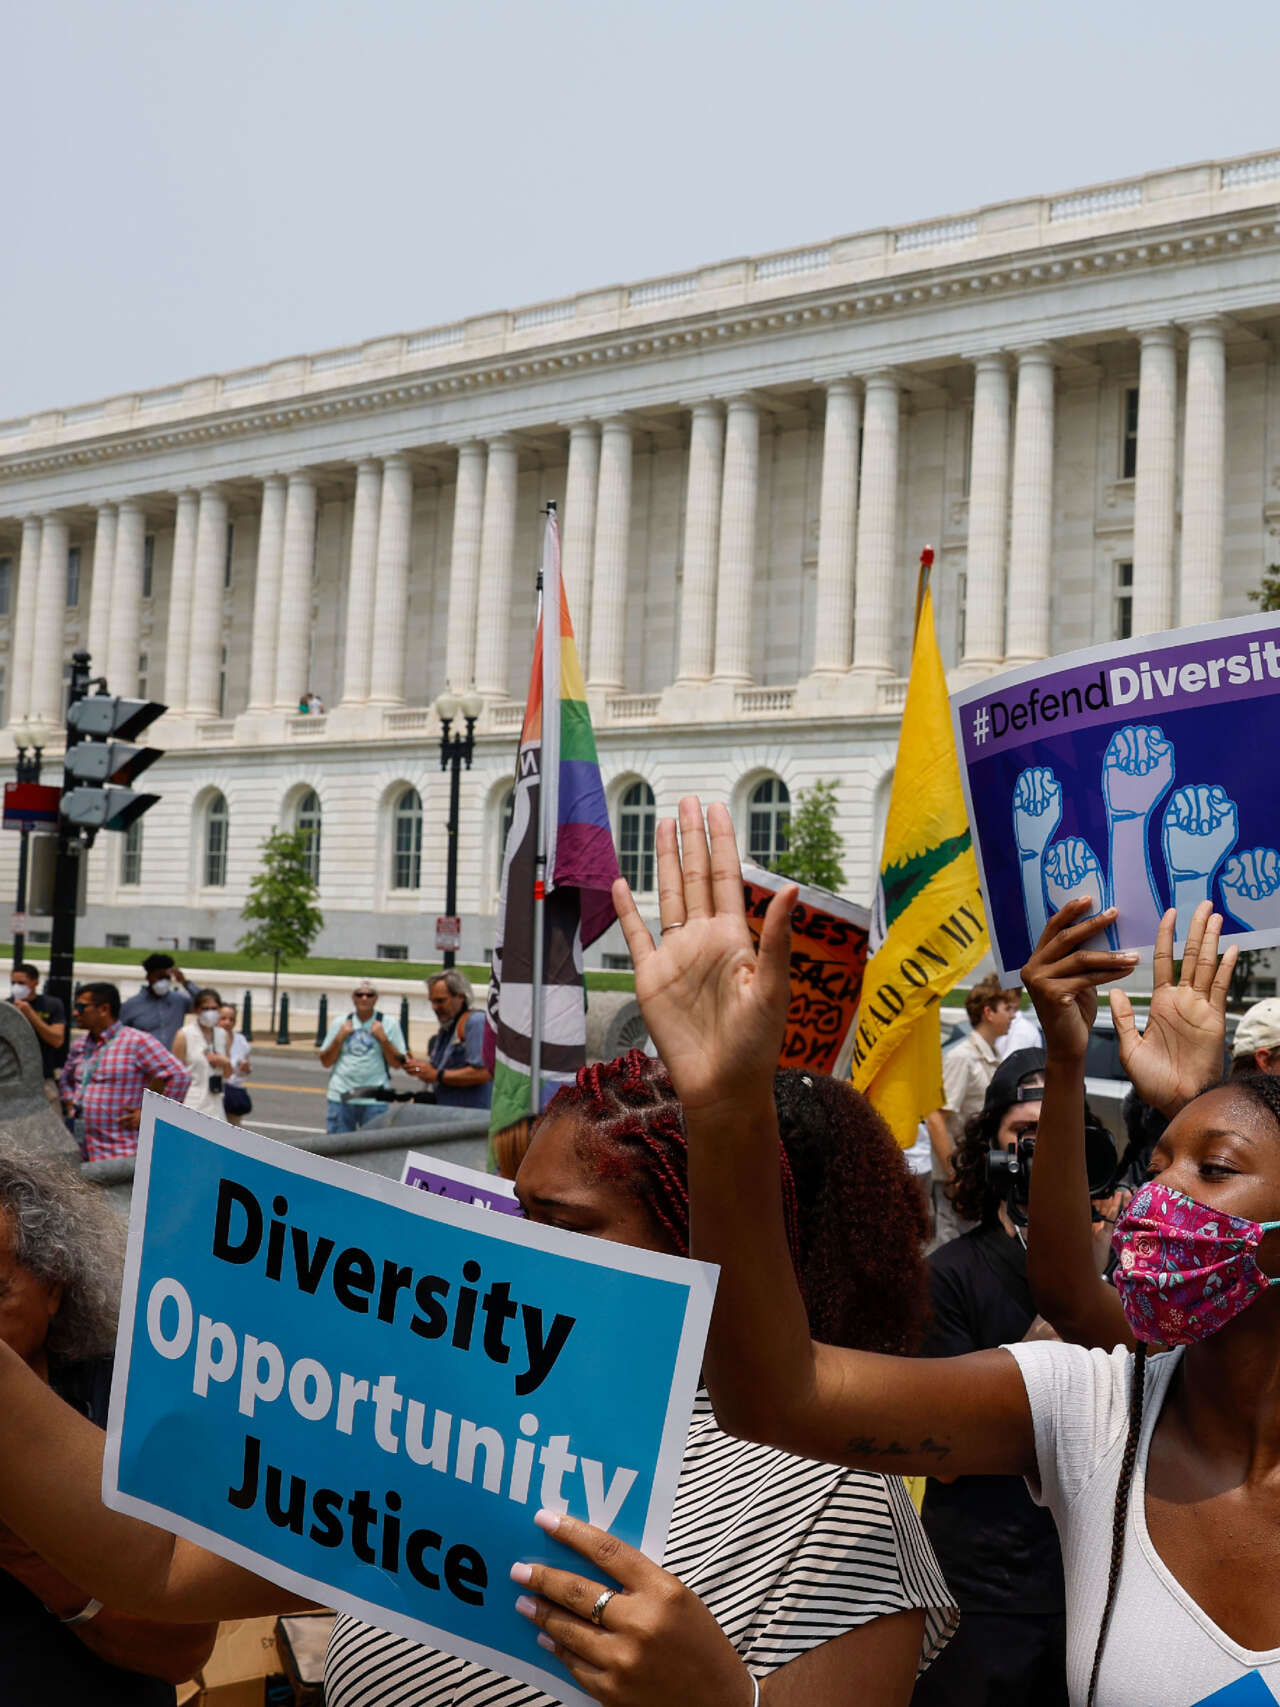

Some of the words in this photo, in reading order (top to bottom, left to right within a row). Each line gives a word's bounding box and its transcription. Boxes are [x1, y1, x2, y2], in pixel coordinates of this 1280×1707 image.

[851, 984, 905, 1081] READ
[900, 939, 950, 988] ON
[939, 900, 984, 953] MY
[211, 1178, 576, 1396] Diversity
[146, 1277, 639, 1534] Opportunity
[227, 1435, 489, 1607] Justice
